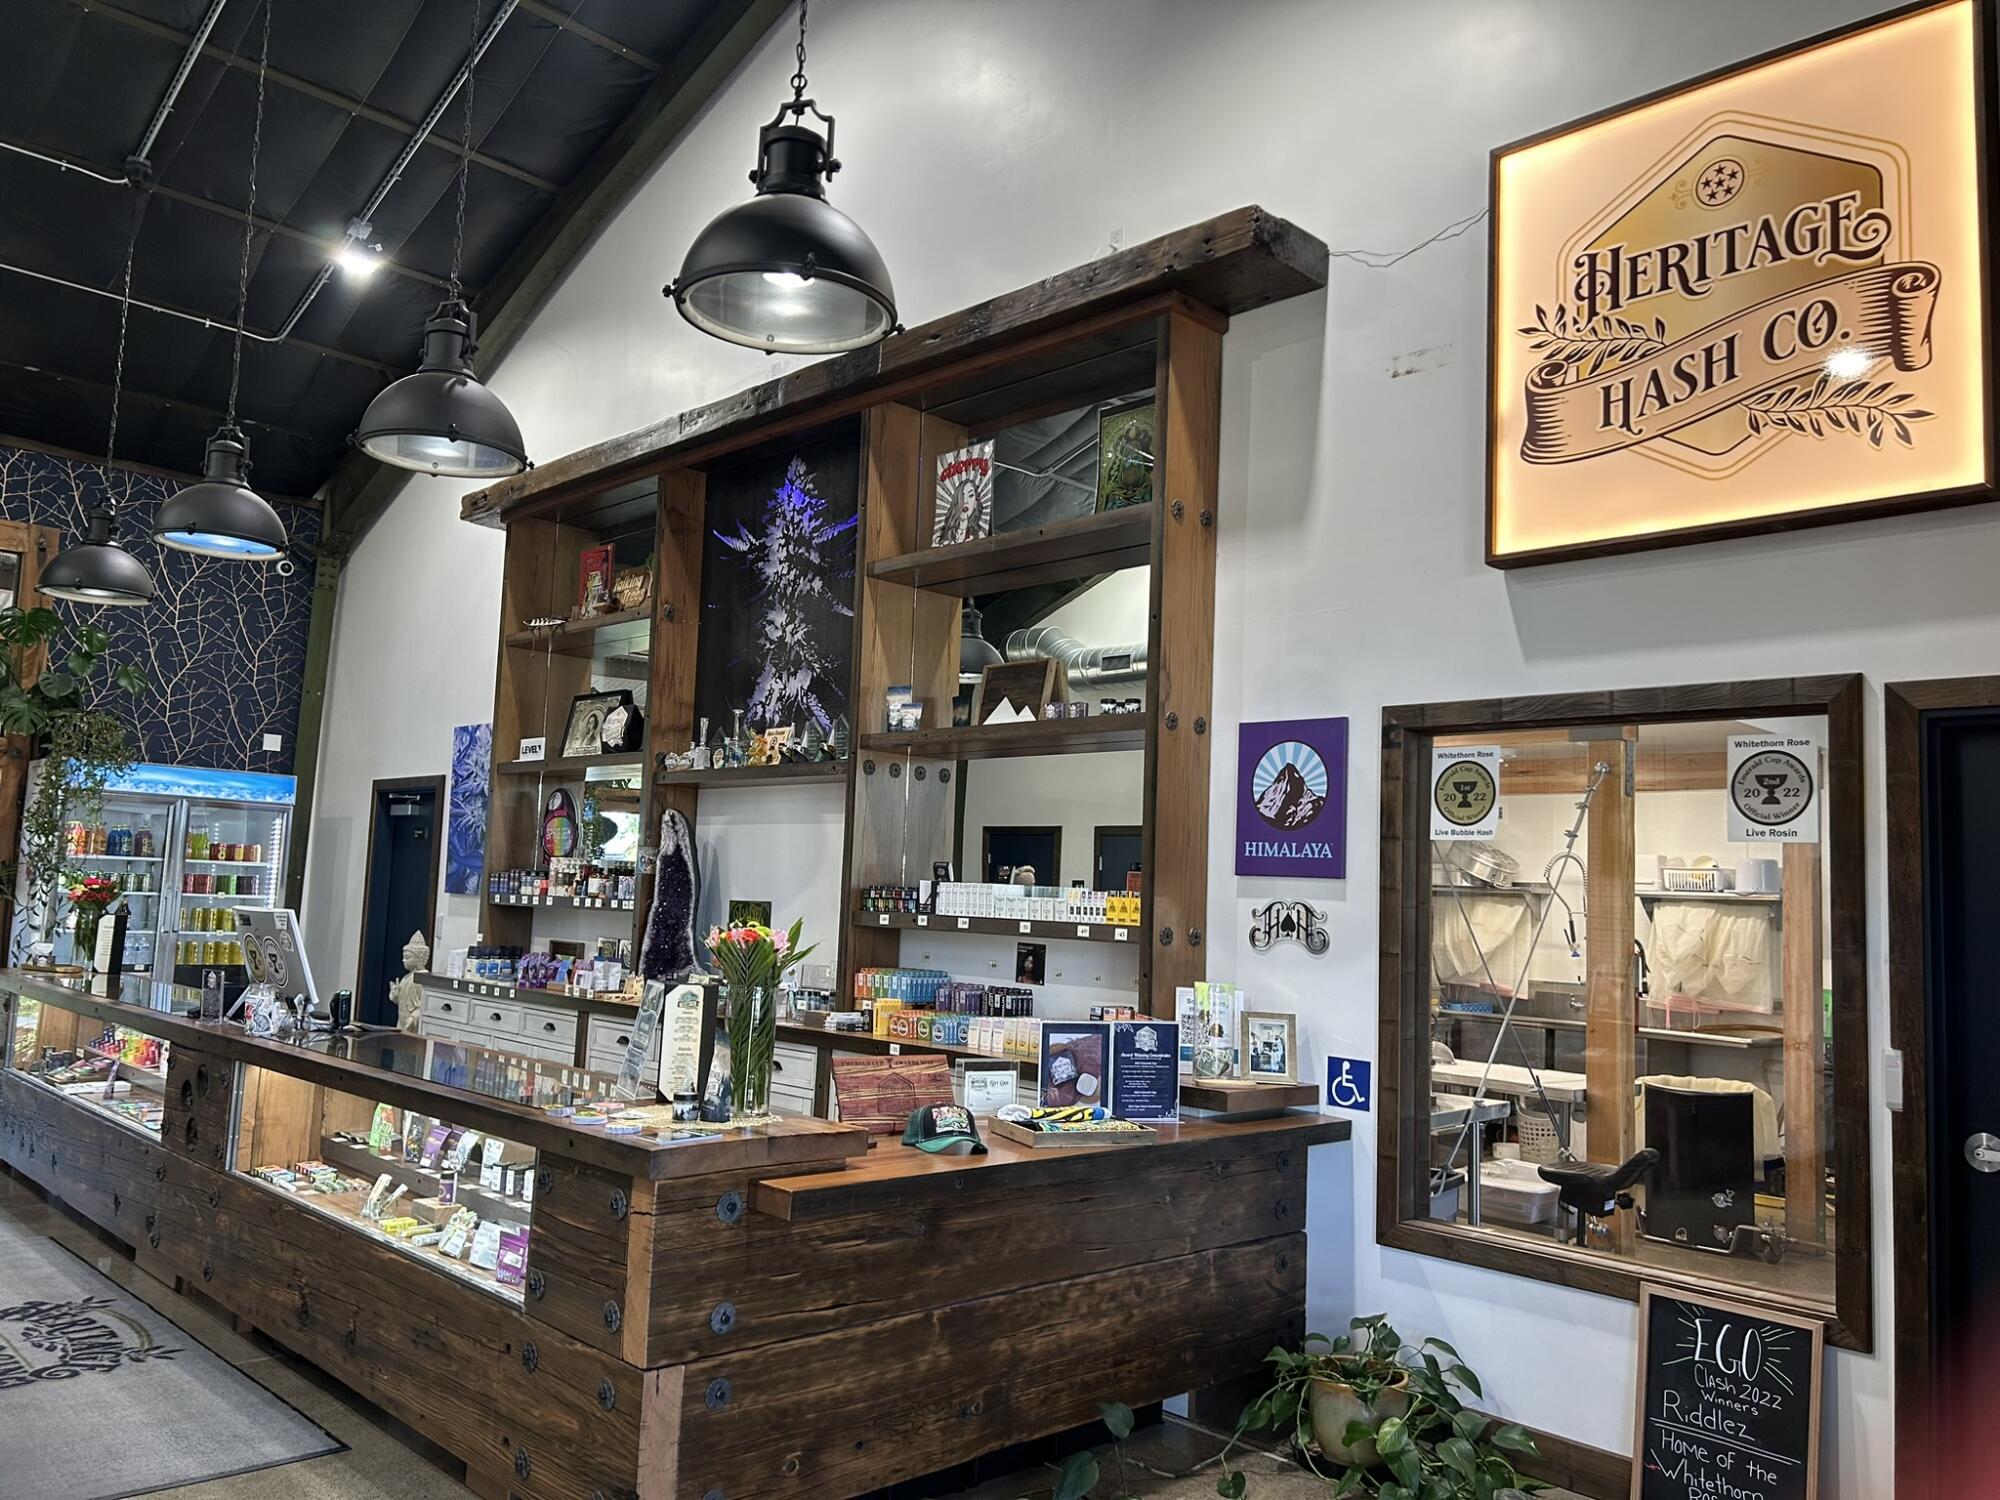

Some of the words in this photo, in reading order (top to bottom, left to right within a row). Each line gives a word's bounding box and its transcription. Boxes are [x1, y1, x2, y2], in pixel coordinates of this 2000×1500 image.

[1574, 192, 1890, 329] HERITAGE
[1598, 336, 1740, 435] HASH
[1762, 297, 1852, 363] CO.
[1734, 740, 1784, 748] Whitethorn
[1787, 739, 1811, 747] Rose
[1763, 777, 1780, 785] 2nd
[1764, 756, 1781, 764] Cup
[1783, 759, 1806, 783] Awards
[1443, 793, 1457, 802] 20
[1473, 793, 1487, 801] 22
[1743, 788, 1760, 798] 20
[1783, 787, 1800, 798] 22
[1743, 802, 1771, 821] Official
[1773, 802, 1800, 820] Winner
[1745, 829, 1766, 837] Live
[1769, 829, 1798, 837] Rosin
[1244, 841, 1333, 859] HIMALAYA
[1694, 1318, 1762, 1381] EGO
[1700, 1389, 1759, 1416] Winners
[1739, 1384, 1782, 1411] 2022
[1663, 1389, 1756, 1442] Riddlez
[1650, 1448, 1764, 1500] Whitethorn
[1746, 1460, 1777, 1486] the
